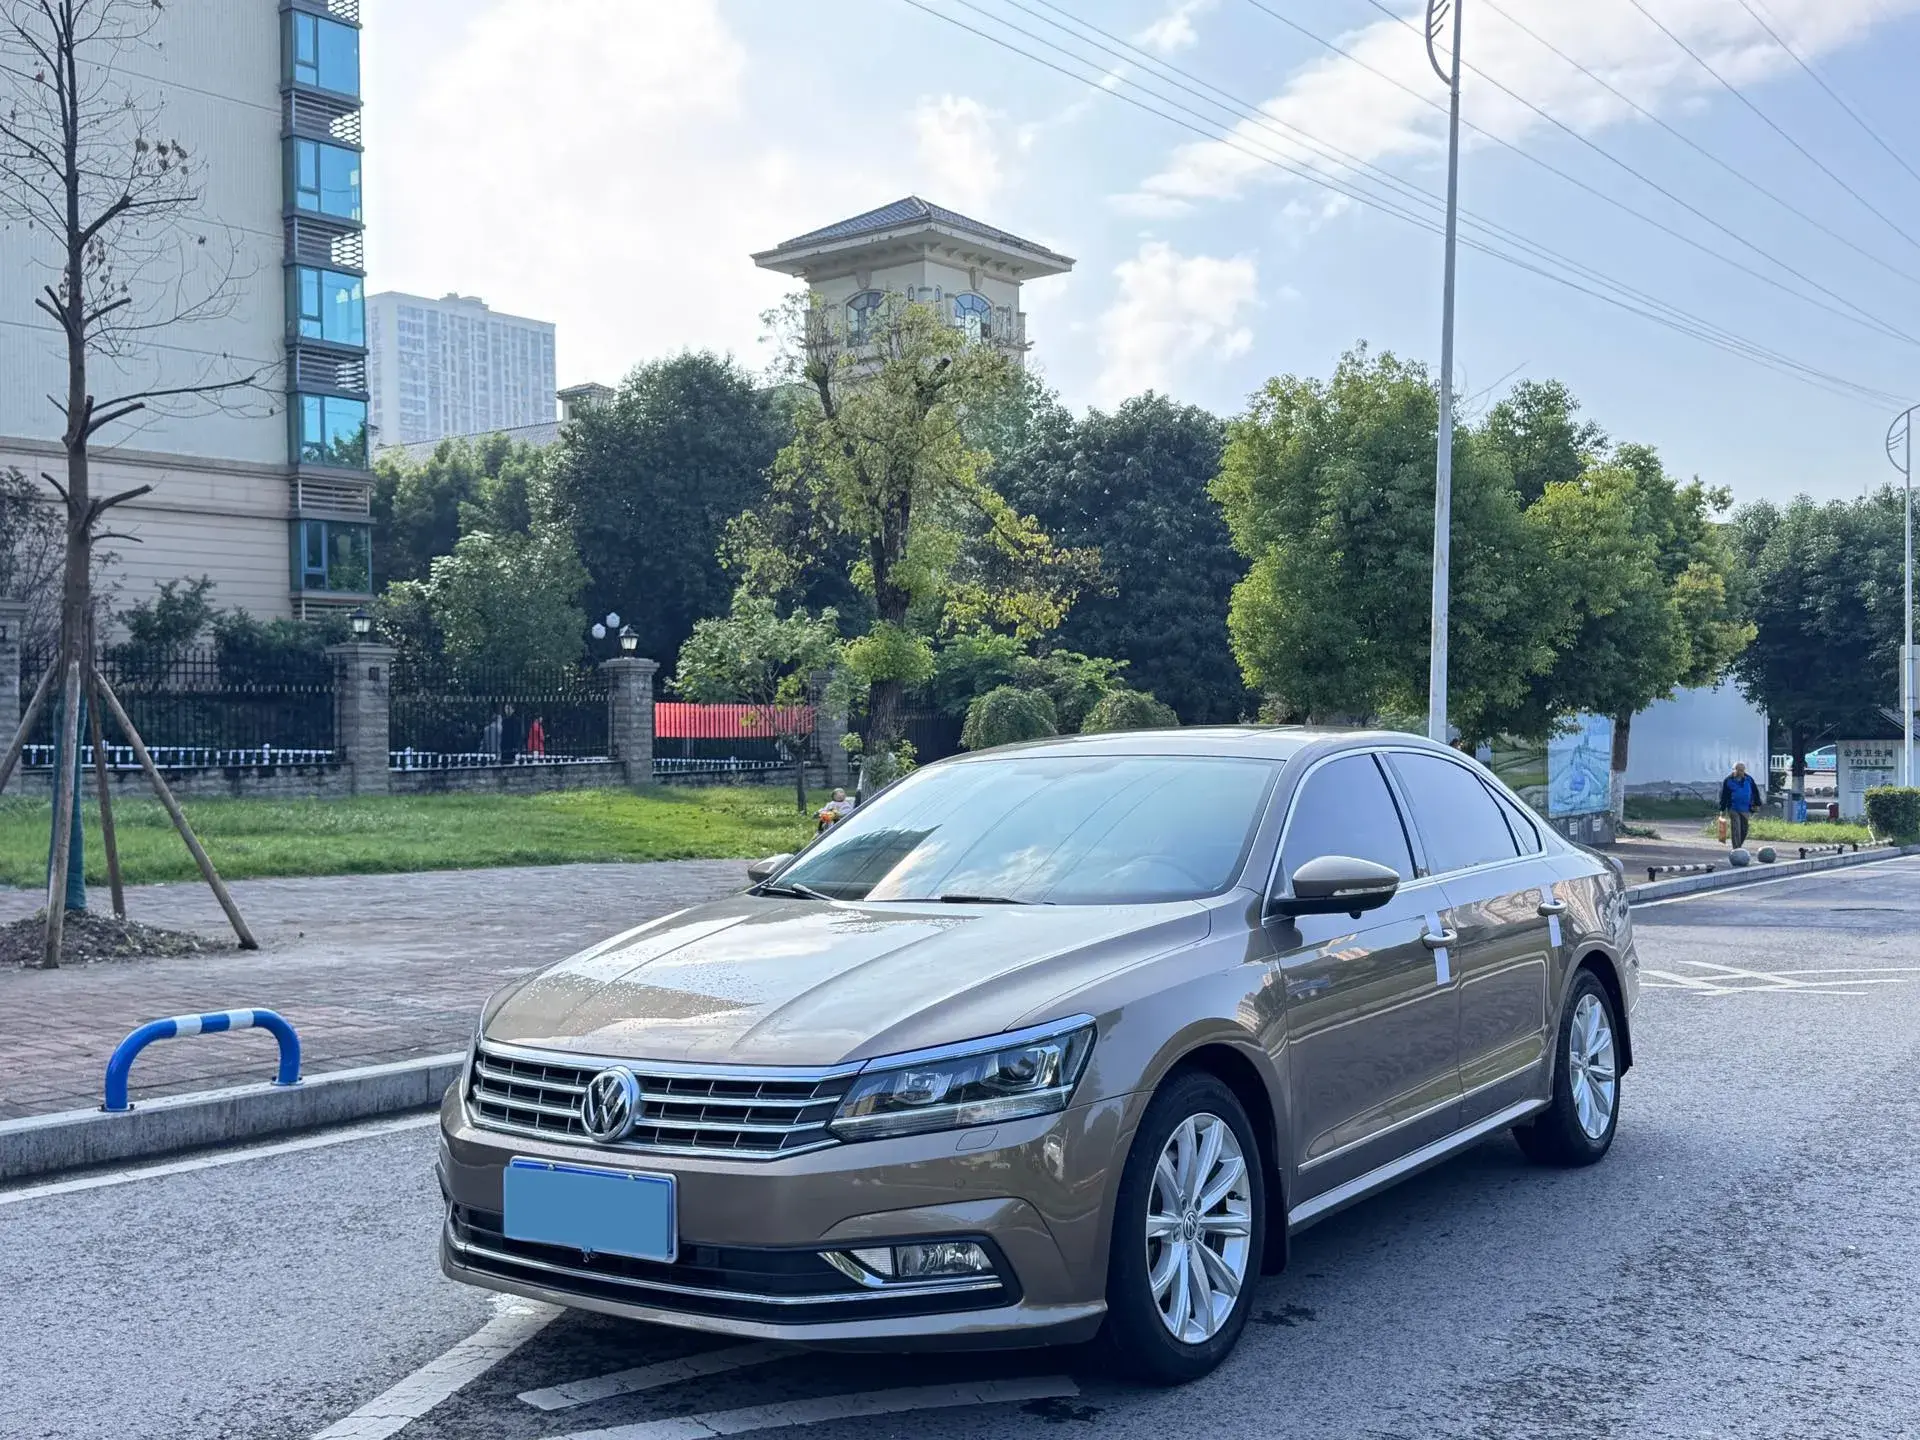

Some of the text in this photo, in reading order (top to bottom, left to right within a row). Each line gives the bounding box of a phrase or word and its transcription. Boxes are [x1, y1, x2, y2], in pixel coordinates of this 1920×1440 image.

[1844, 748, 1893, 758] 公共卫生间
